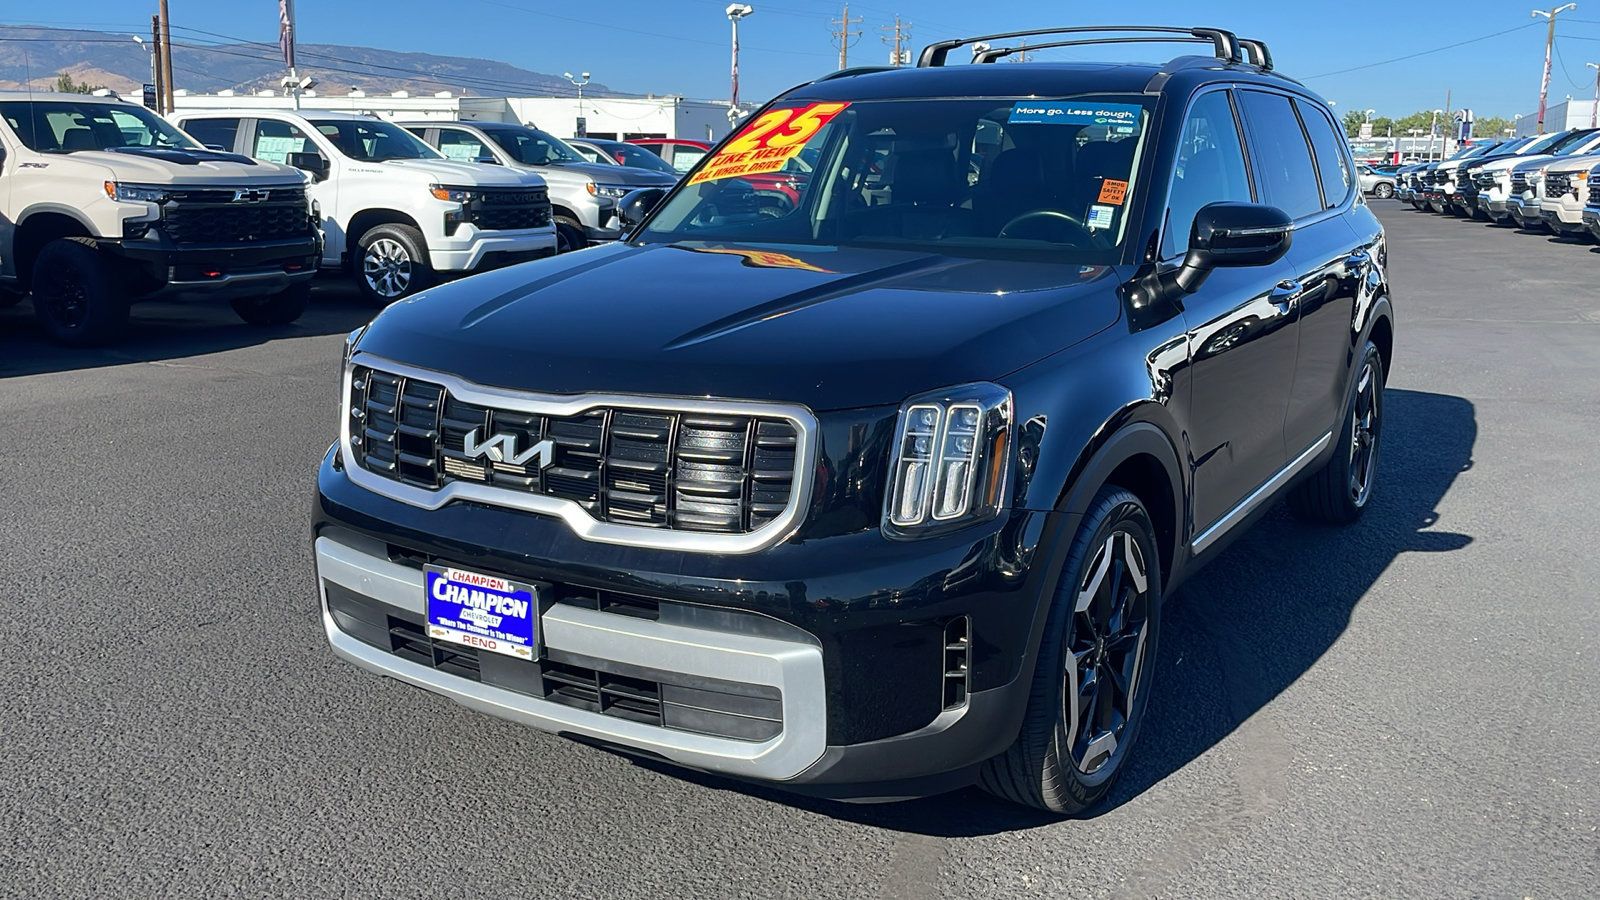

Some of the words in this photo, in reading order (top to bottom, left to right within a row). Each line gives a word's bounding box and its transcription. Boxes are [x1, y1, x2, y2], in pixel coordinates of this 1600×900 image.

[1046, 108, 1064, 116] go.
[1067, 108, 1092, 116] Less
[1095, 110, 1135, 119] dough.
[721, 103, 846, 154] 25
[711, 152, 748, 168] LIKE
[749, 145, 796, 161] NEW
[692, 171, 712, 183] ALL
[712, 164, 748, 178] WHEEL
[748, 159, 784, 172] DRIVE
[1103, 187, 1124, 195] SAFETY
[452, 571, 504, 590] CHAMPION
[433, 577, 528, 619] CHAMPION
[462, 610, 499, 625] CHEVROLET
[457, 621, 466, 630] The
[496, 631, 506, 639] The
[463, 635, 497, 650] RENO
